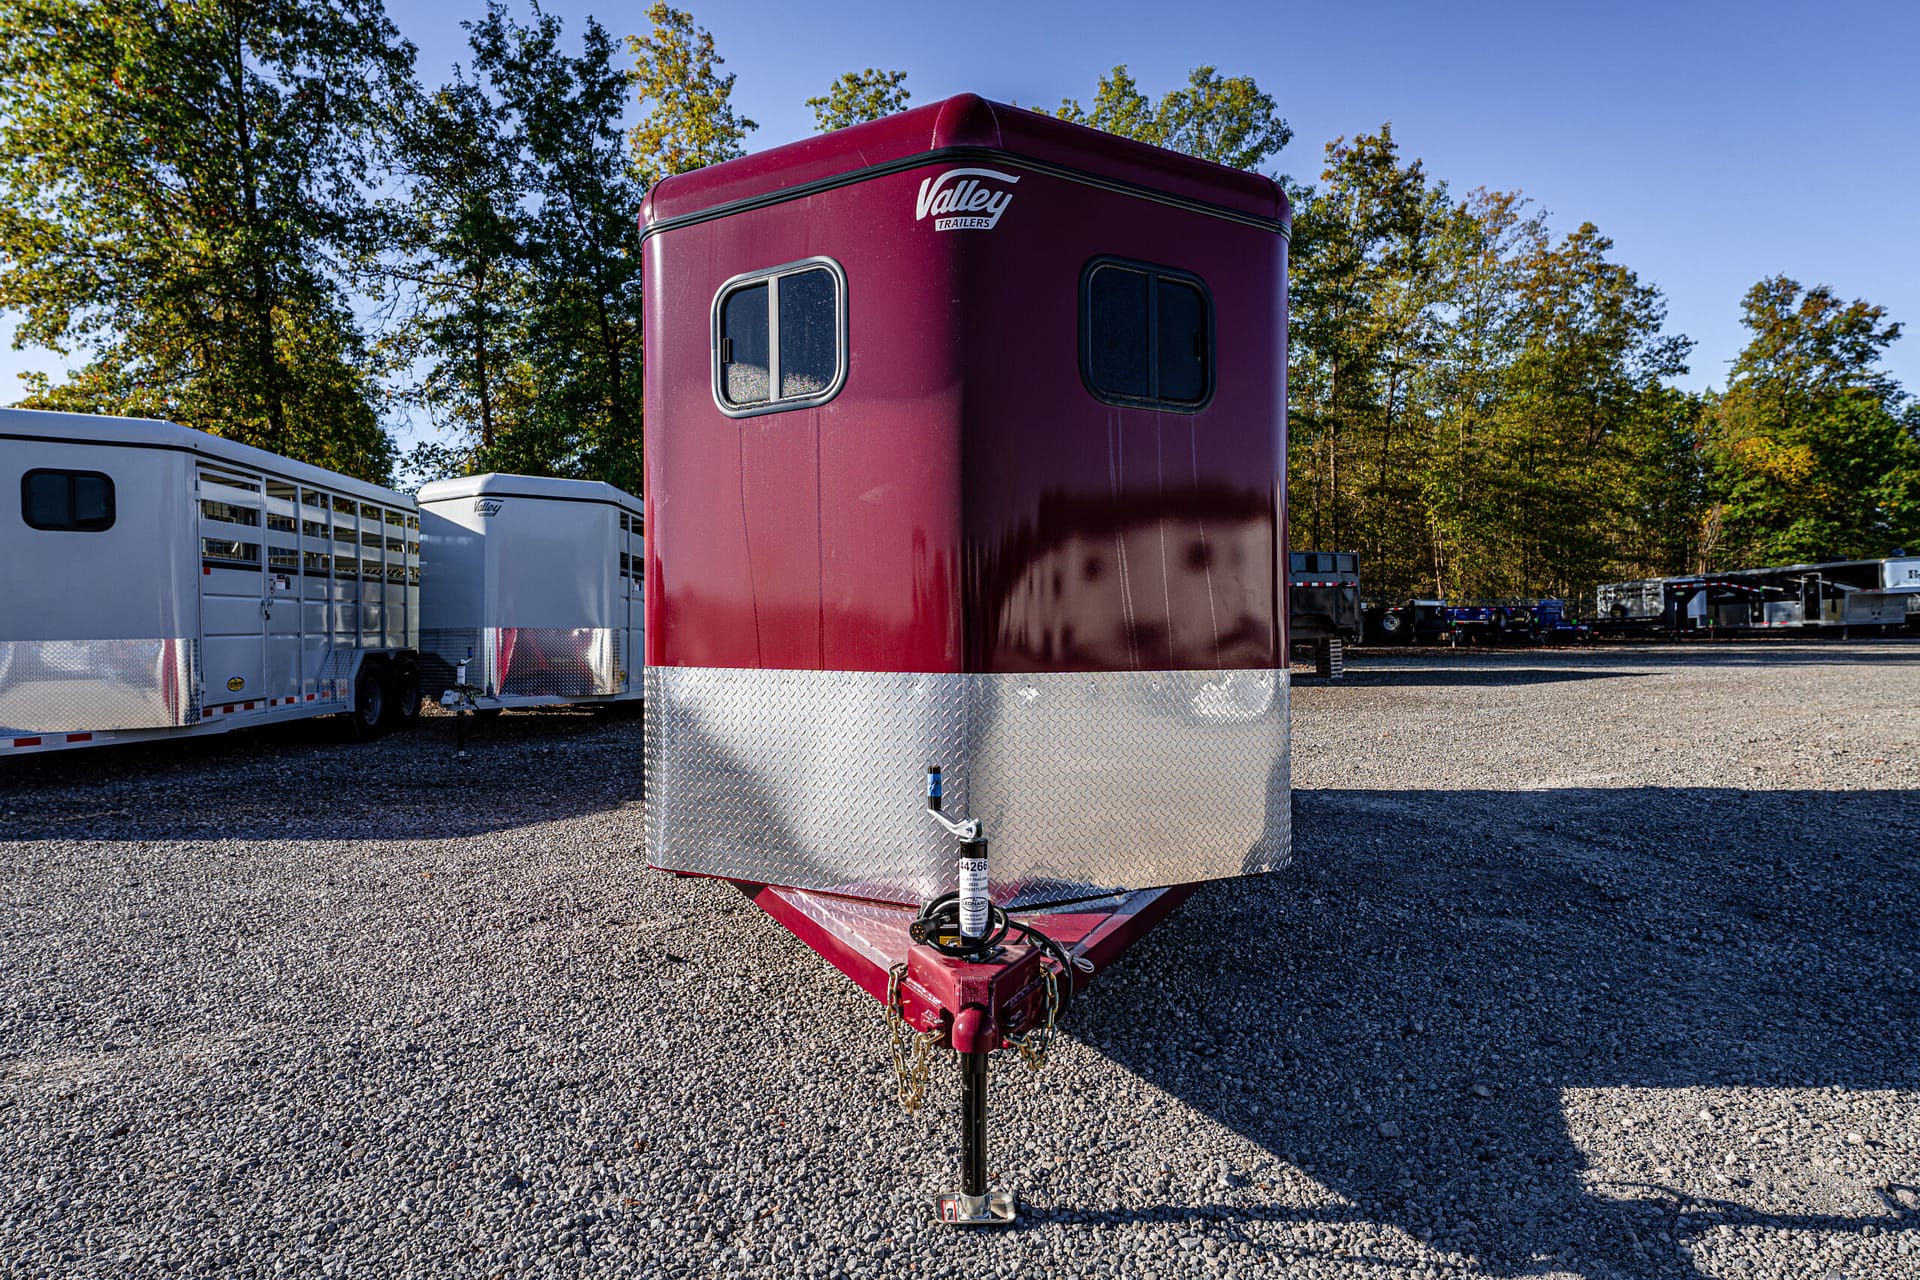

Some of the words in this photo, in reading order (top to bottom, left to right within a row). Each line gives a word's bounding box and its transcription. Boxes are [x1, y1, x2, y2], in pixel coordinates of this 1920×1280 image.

[916, 168, 1020, 221] Valley
[939, 218, 991, 229] TRAILERS
[474, 498, 504, 516] Valley
